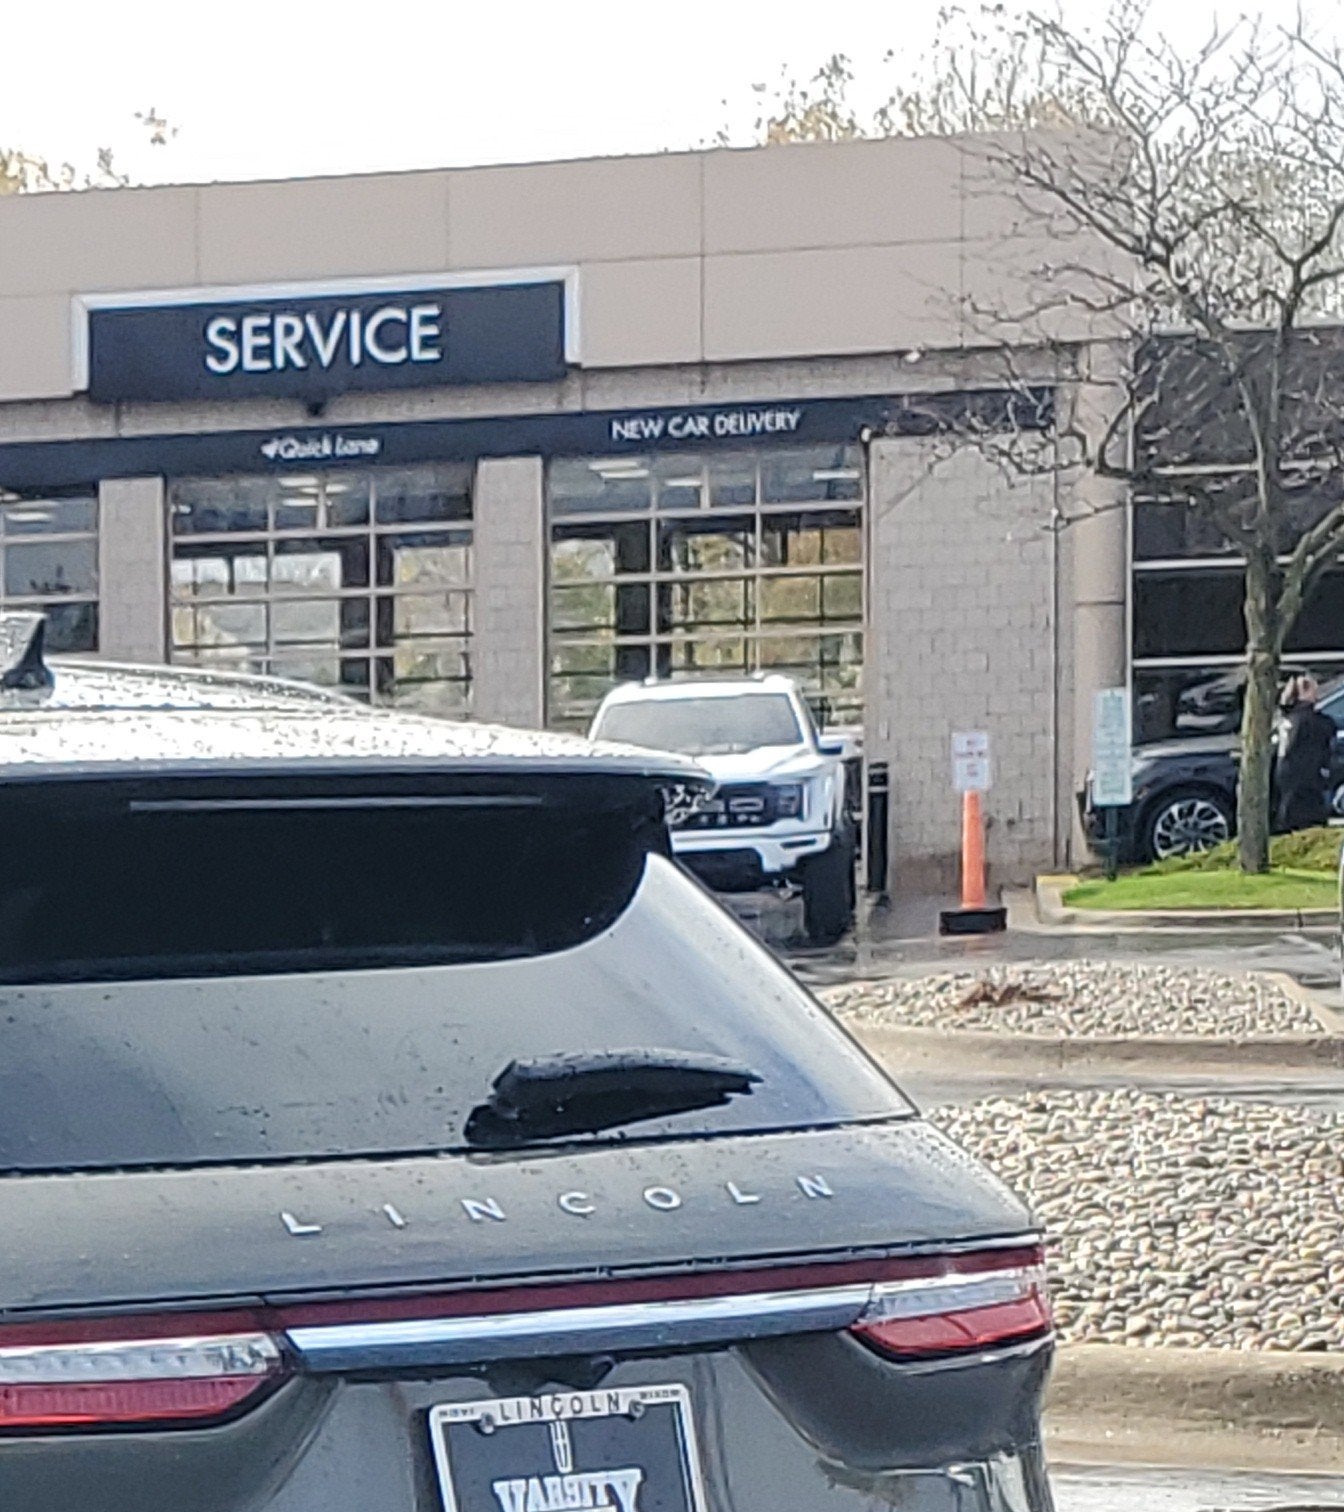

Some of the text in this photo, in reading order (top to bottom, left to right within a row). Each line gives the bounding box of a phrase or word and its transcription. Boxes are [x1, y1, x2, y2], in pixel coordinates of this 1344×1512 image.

[205, 303, 442, 374] SERVICE
[612, 408, 802, 440] NEW CAR DELIVERY
[281, 1174, 834, 1237] LINCOLN
[499, 1393, 621, 1422] LINCOLN
